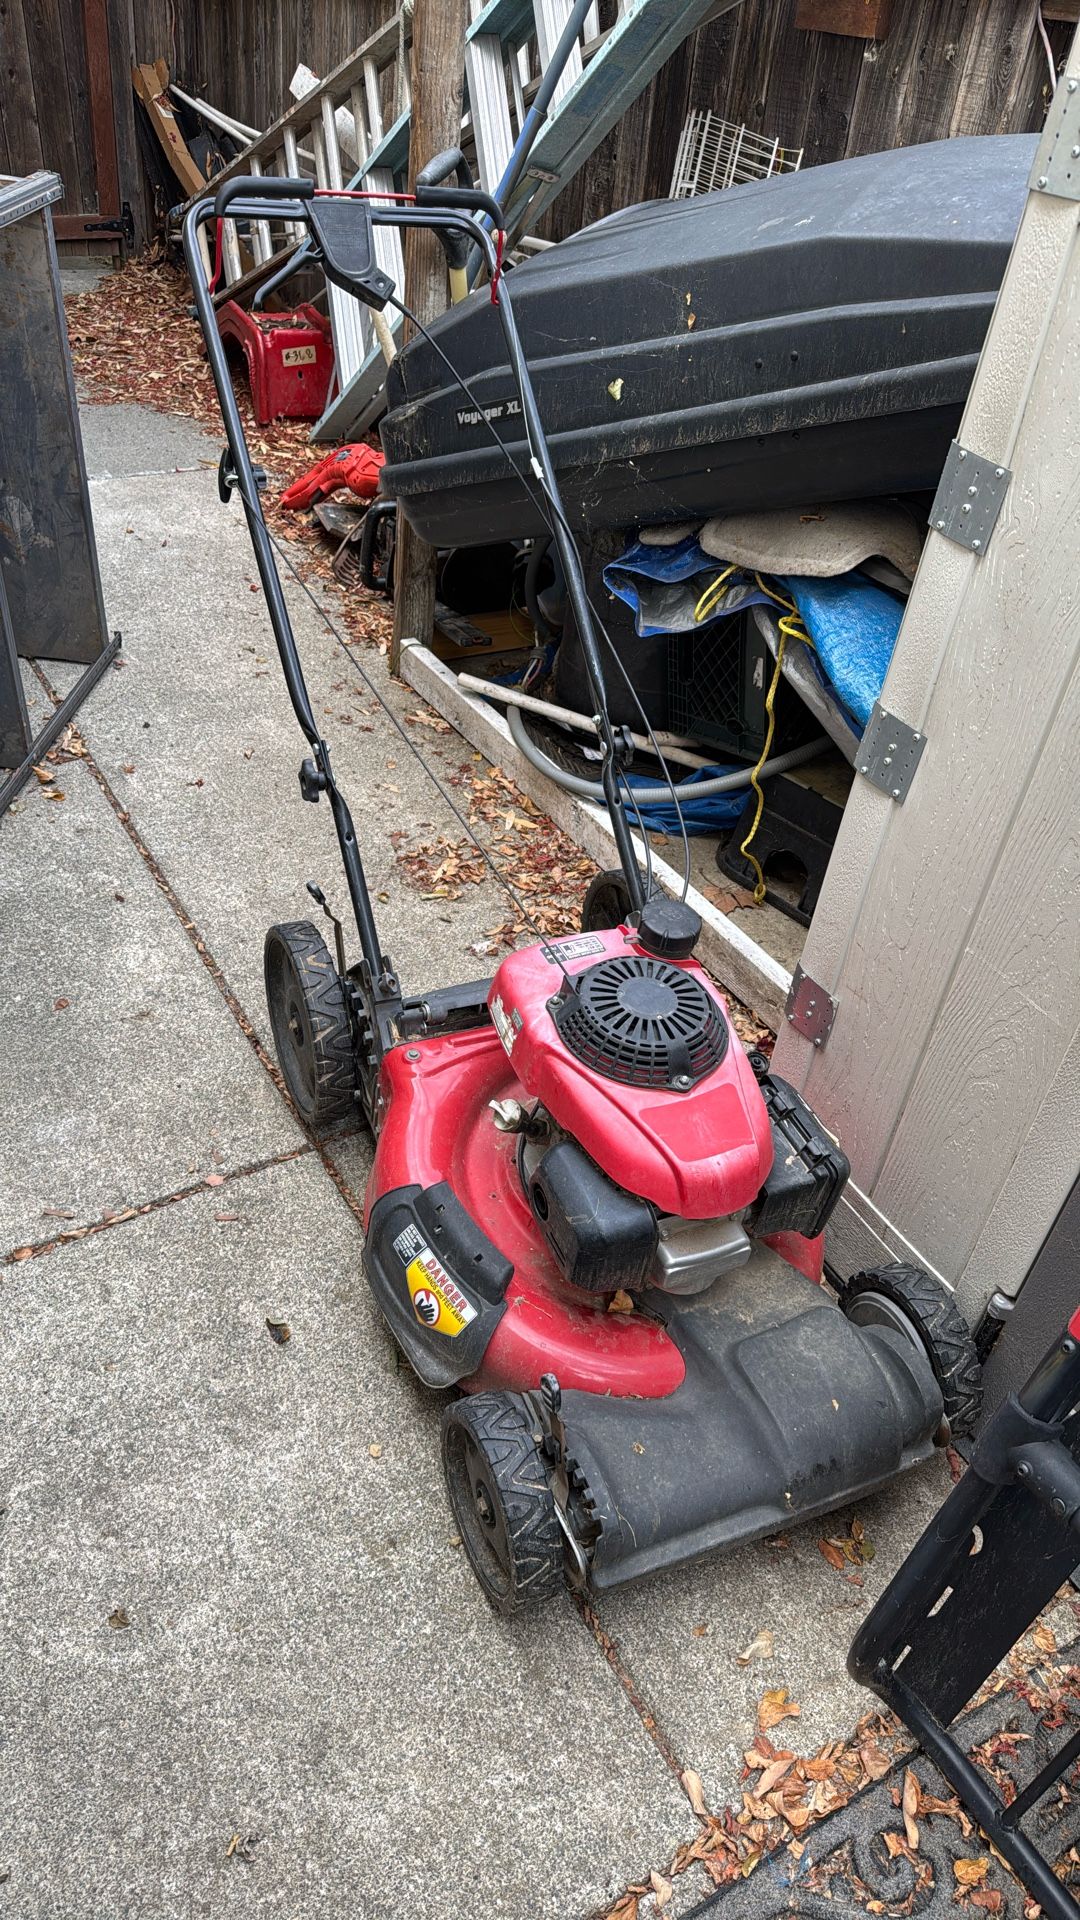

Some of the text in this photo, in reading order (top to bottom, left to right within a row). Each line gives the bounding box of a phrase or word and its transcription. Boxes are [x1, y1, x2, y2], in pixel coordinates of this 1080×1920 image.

[506, 400, 521, 415] XL
[415, 1260, 466, 1325] KEEP HANDS and FEET AWAY
[425, 1258, 468, 1313] DANGER
